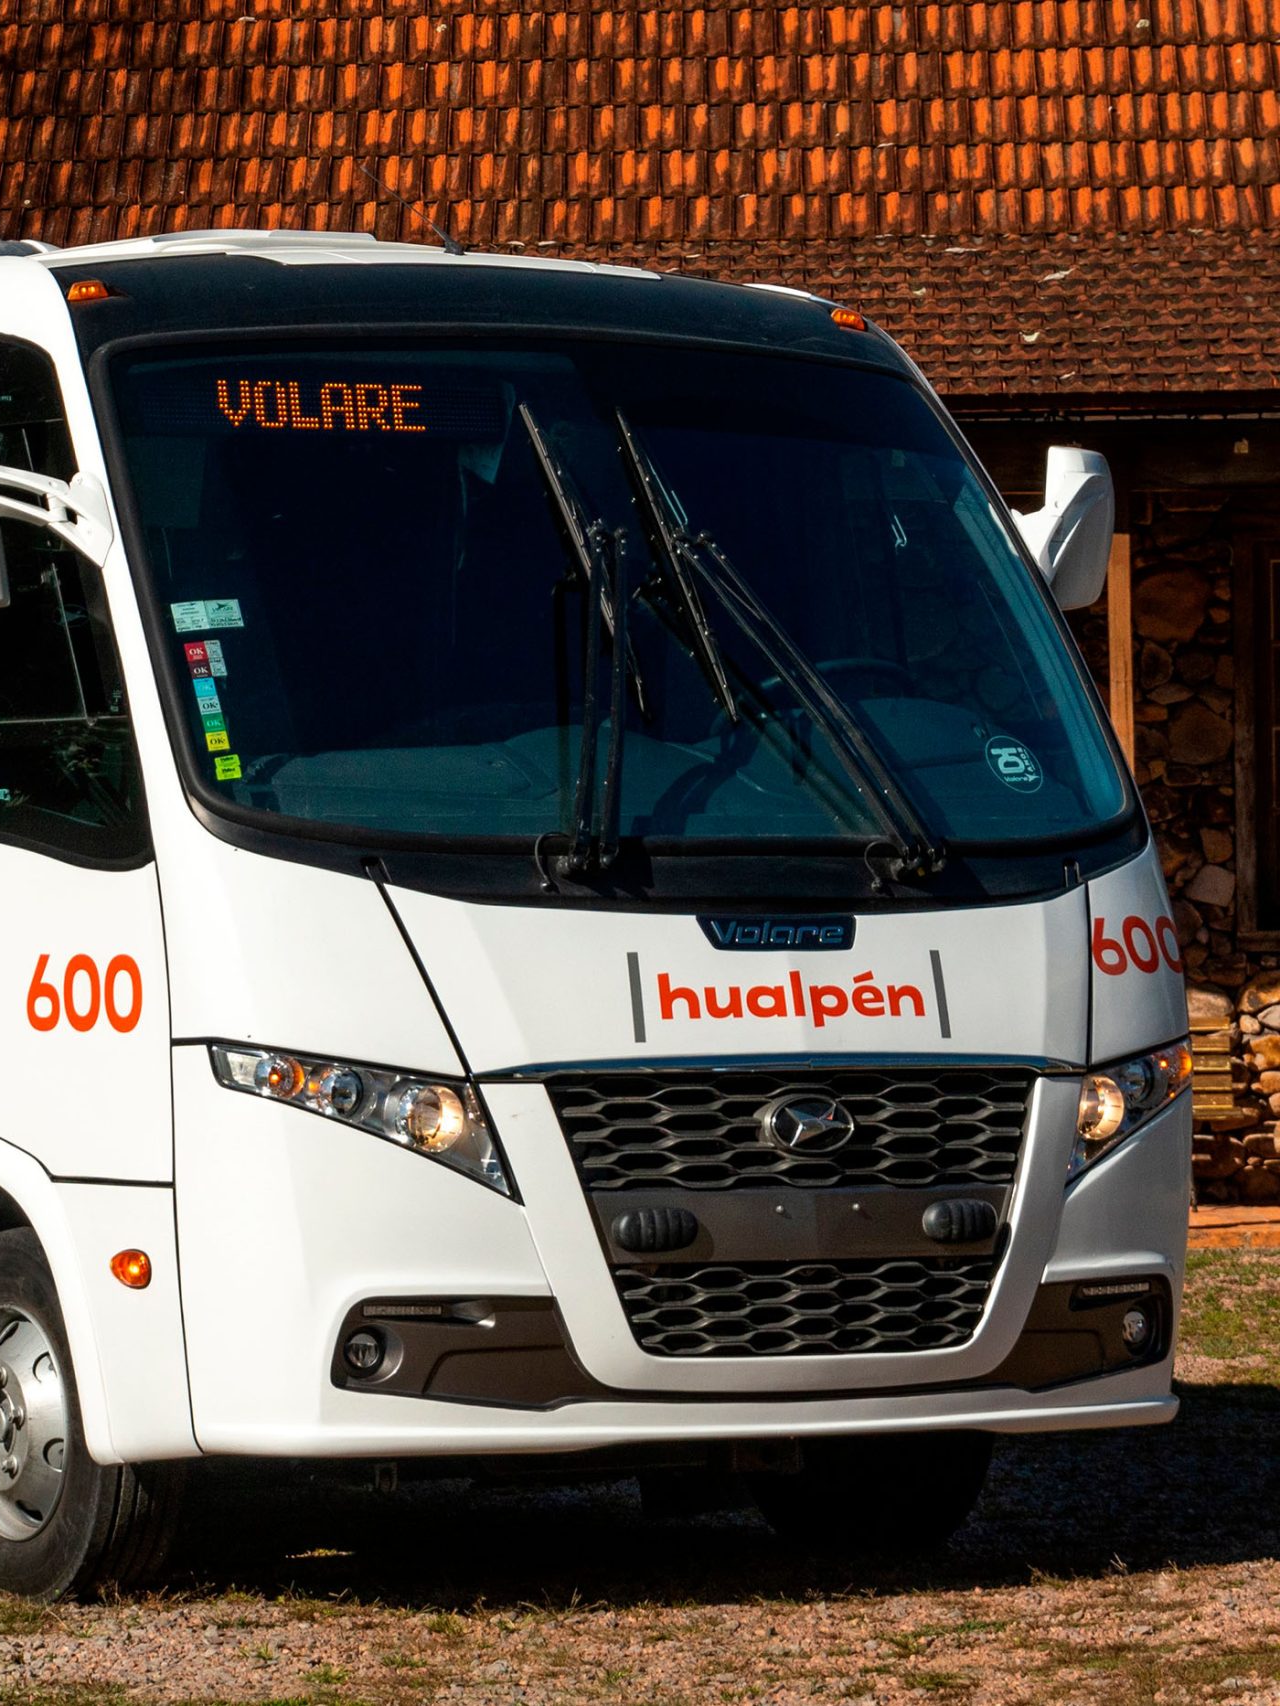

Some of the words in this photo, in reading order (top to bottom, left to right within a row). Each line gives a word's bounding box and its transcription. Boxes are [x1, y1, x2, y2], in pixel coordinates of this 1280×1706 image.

[217, 379, 427, 431] VOLARE
[189, 647, 204, 656] OK
[193, 666, 208, 675] OK
[710, 920, 844, 945] Volare
[1092, 915, 1183, 976] 600
[26, 953, 143, 1033] 600
[657, 970, 926, 1028] hualpén
